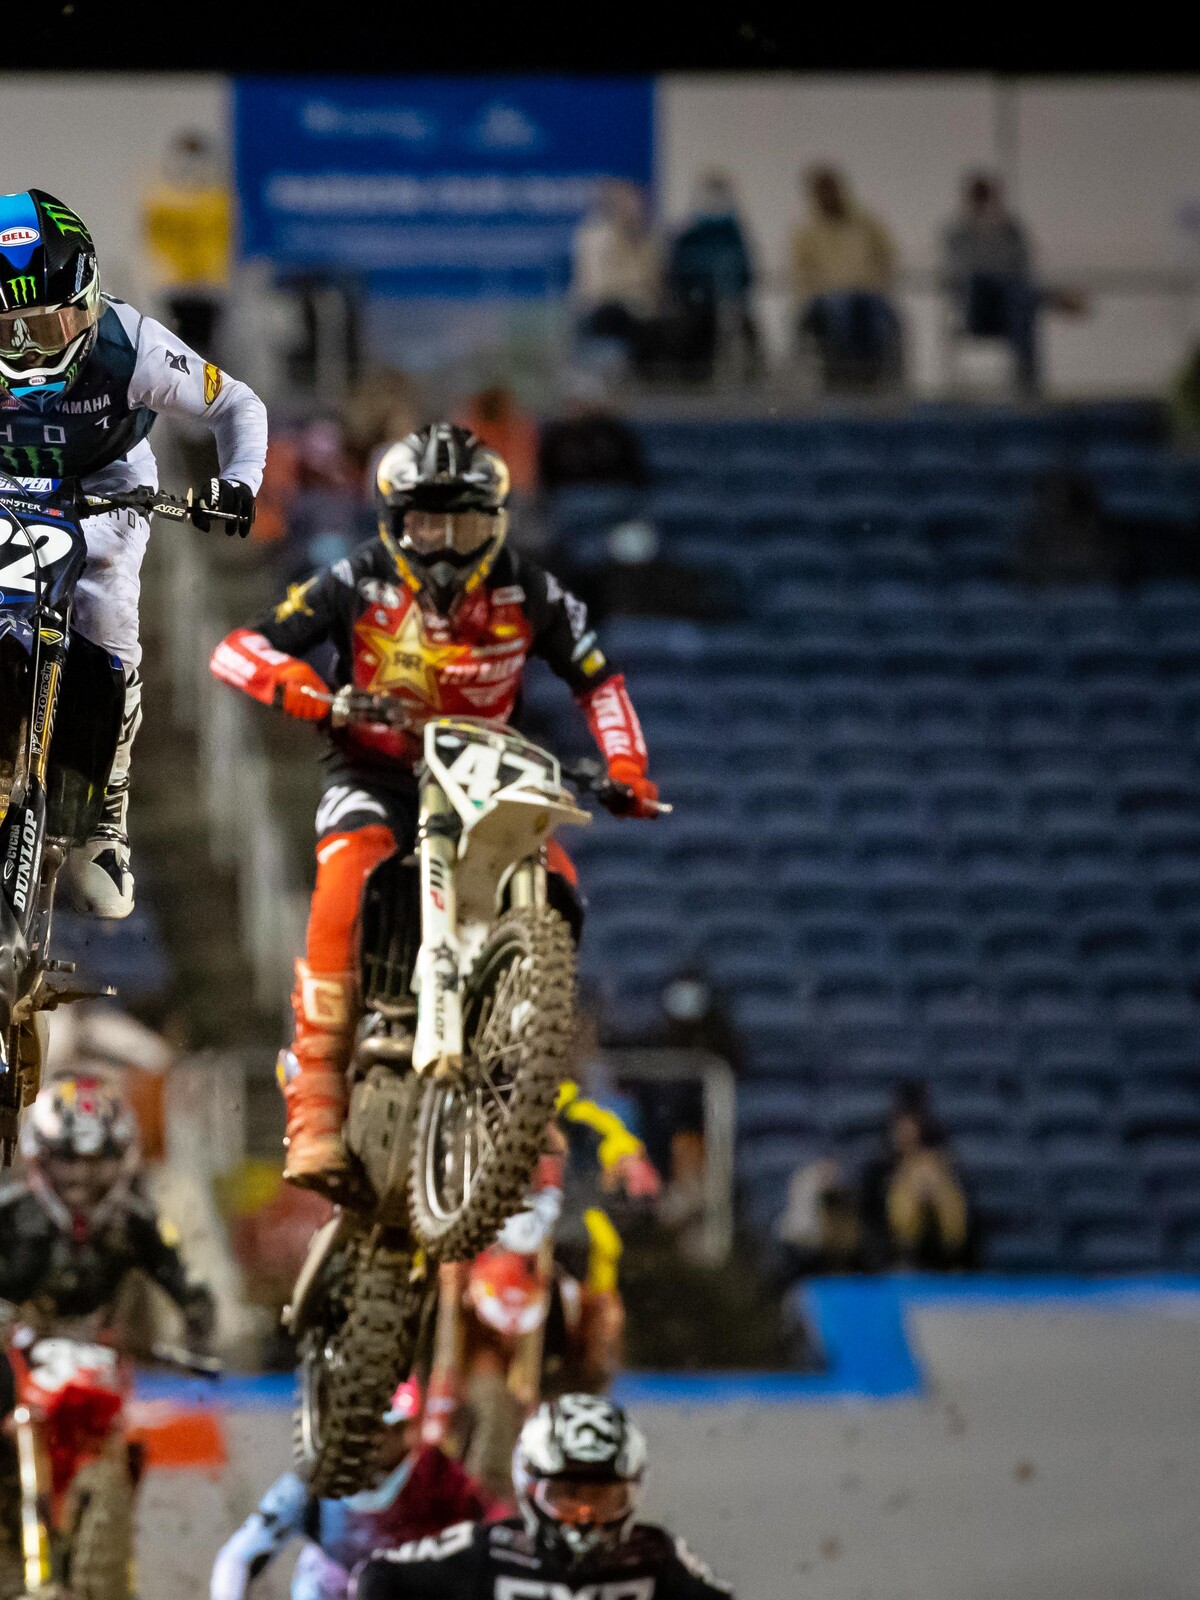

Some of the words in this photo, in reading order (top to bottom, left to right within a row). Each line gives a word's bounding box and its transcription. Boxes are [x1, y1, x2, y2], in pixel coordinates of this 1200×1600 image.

[2, 231, 32, 242] BELL
[55, 393, 111, 415] YAMAHA
[153, 503, 186, 518] ARC
[34, 660, 54, 733] enzoracin
[7, 824, 21, 860] CYCRA
[13, 808, 38, 913] DUNLOP
